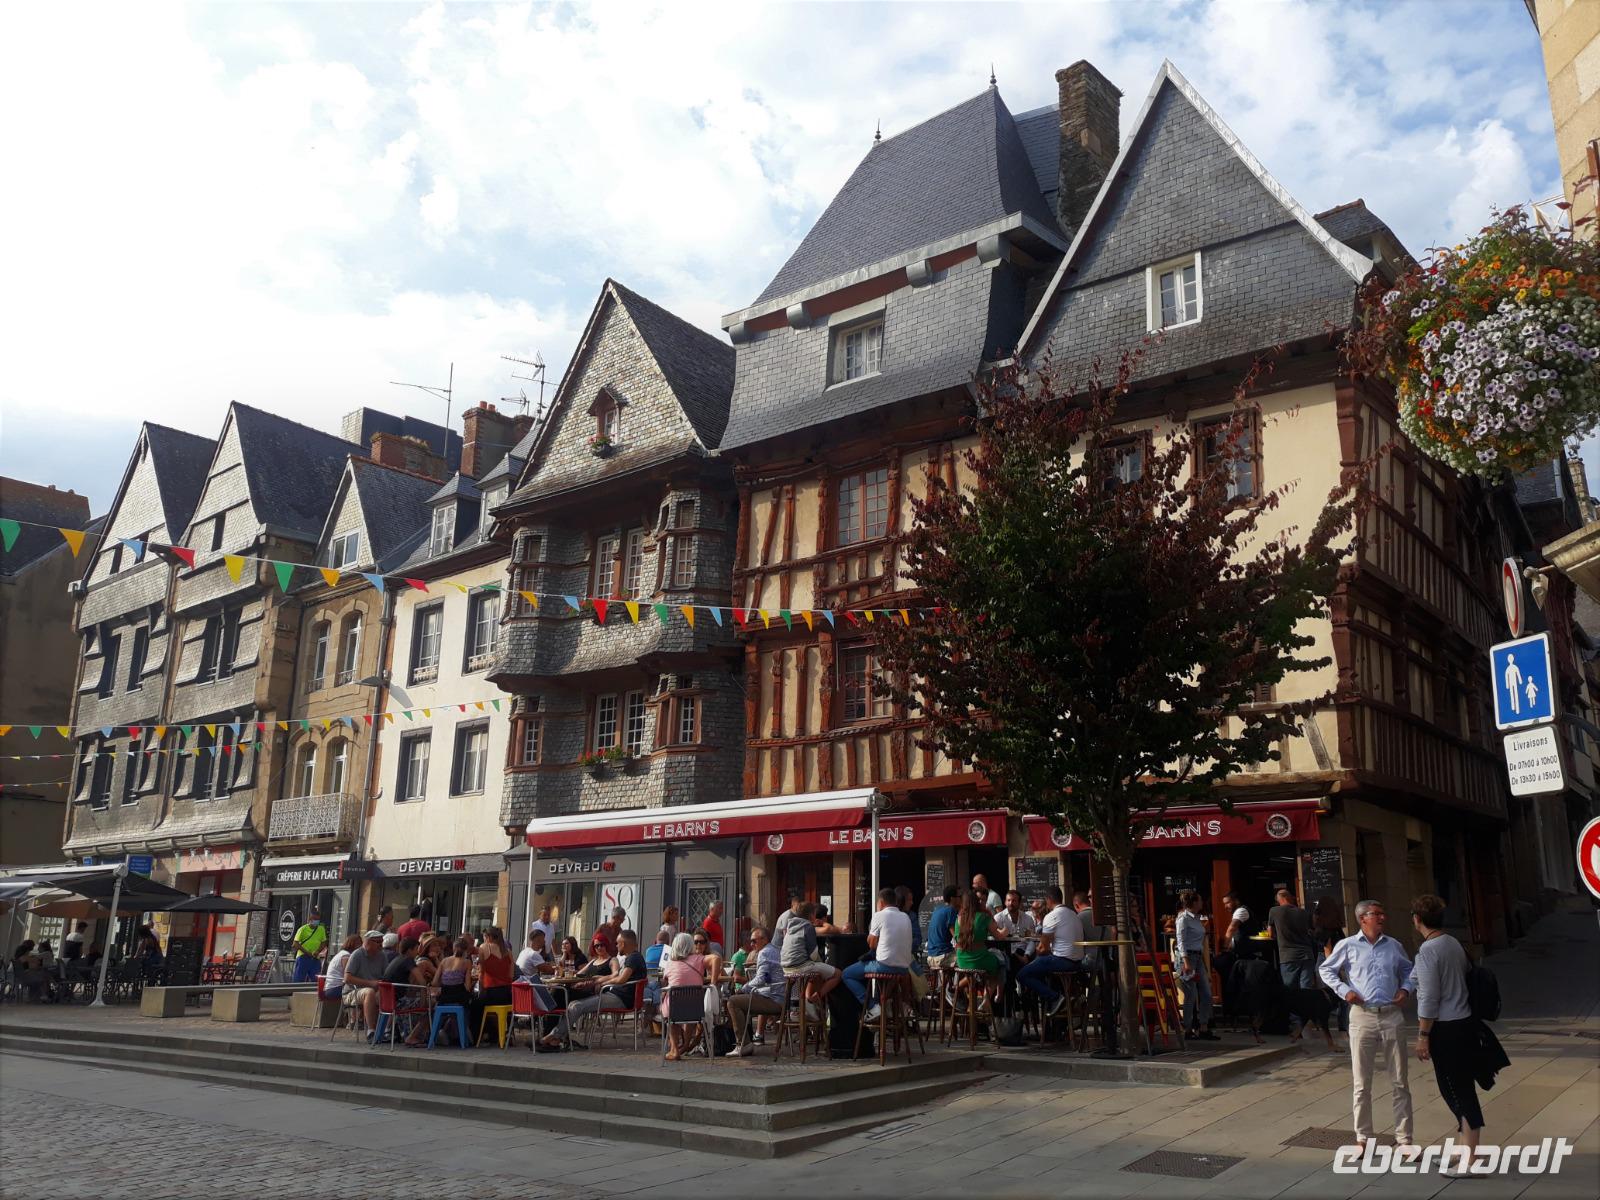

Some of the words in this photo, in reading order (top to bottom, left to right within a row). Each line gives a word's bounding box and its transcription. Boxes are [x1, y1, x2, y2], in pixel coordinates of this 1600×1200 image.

[1513, 737, 1548, 751] Livraisons
[1510, 763, 1517, 771] De
[1518, 759, 1535, 769] 07h00
[1536, 758, 1540, 766] à
[1541, 755, 1558, 765] 10h00
[1511, 777, 1519, 785] De
[1520, 773, 1537, 784] 13h30
[1543, 770, 1561, 780] 15h00
[643, 824, 661, 839] LE
[664, 820, 720, 838] BARN'S
[829, 830, 849, 844] LE
[277, 870, 302, 881] CRÊPERIE
[303, 870, 311, 880] DE
[312, 869, 320, 880] LA
[320, 869, 338, 880] PLACE
